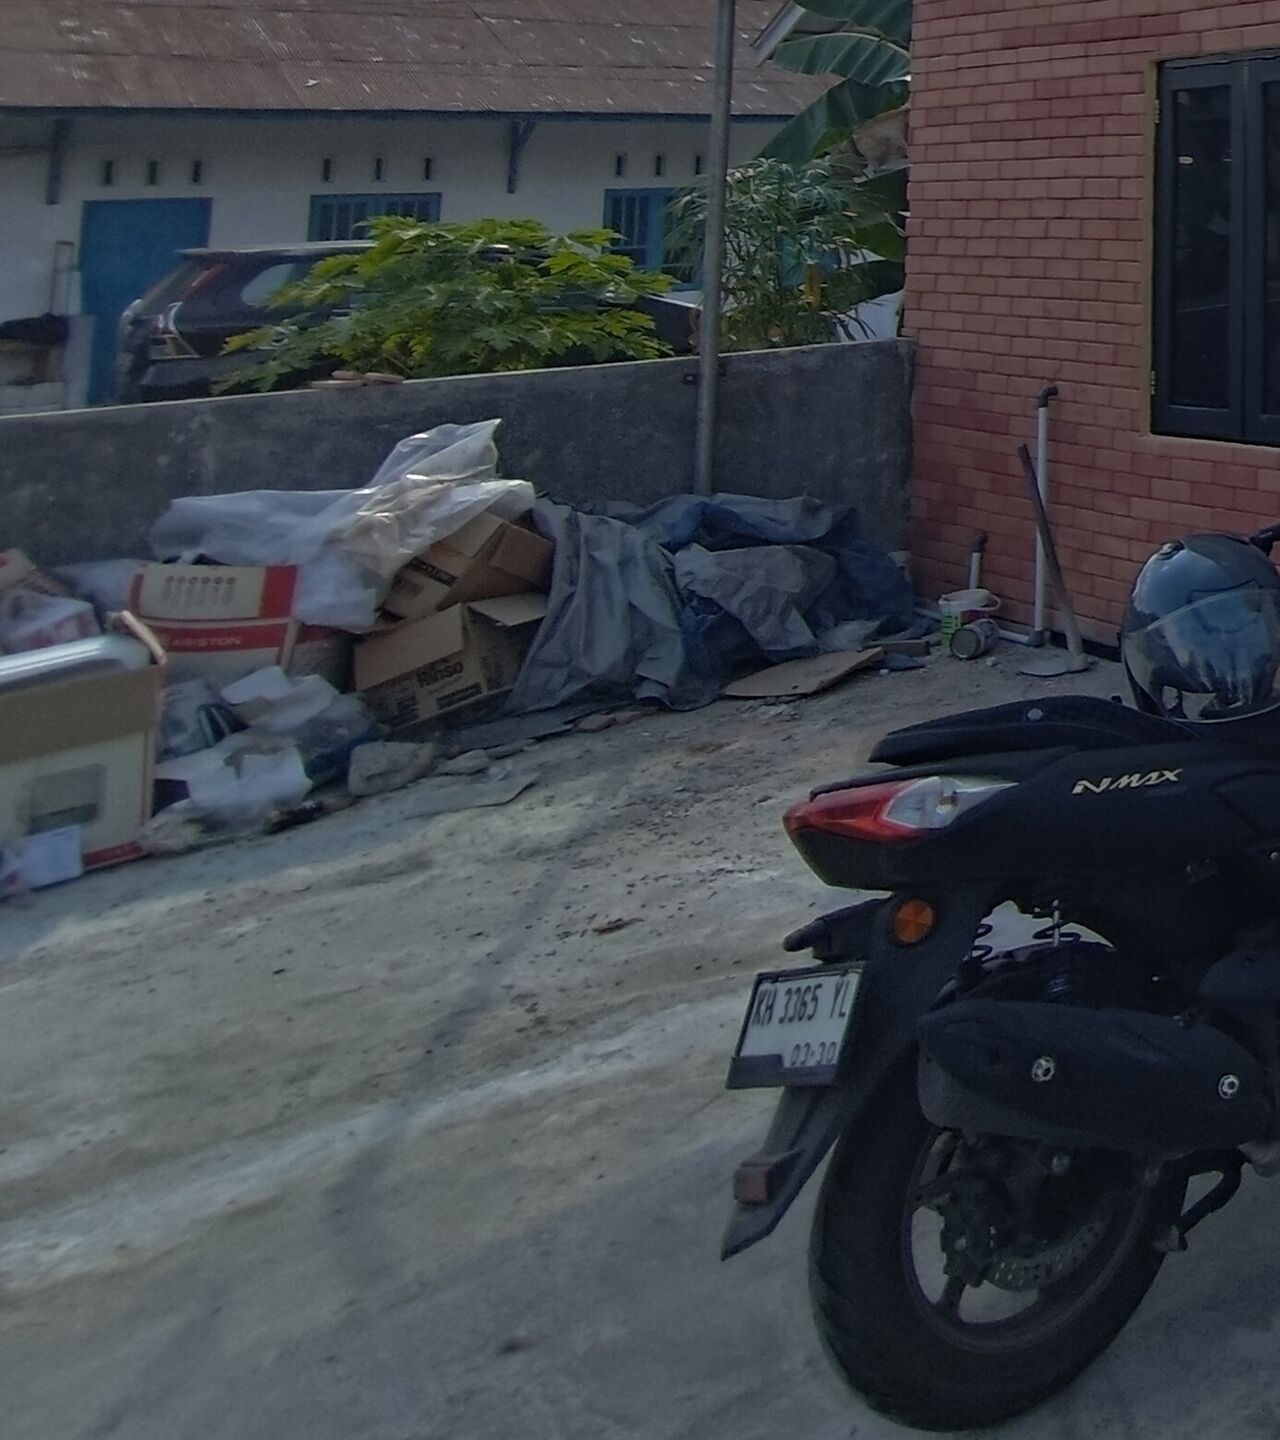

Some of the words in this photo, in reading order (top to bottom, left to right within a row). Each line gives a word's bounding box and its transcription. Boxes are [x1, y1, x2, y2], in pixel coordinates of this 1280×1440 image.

[1071, 768, 1185, 795] NMAX
[752, 989, 777, 1026] KH
[778, 983, 823, 1024] 3365
[829, 979, 851, 1019] YL
